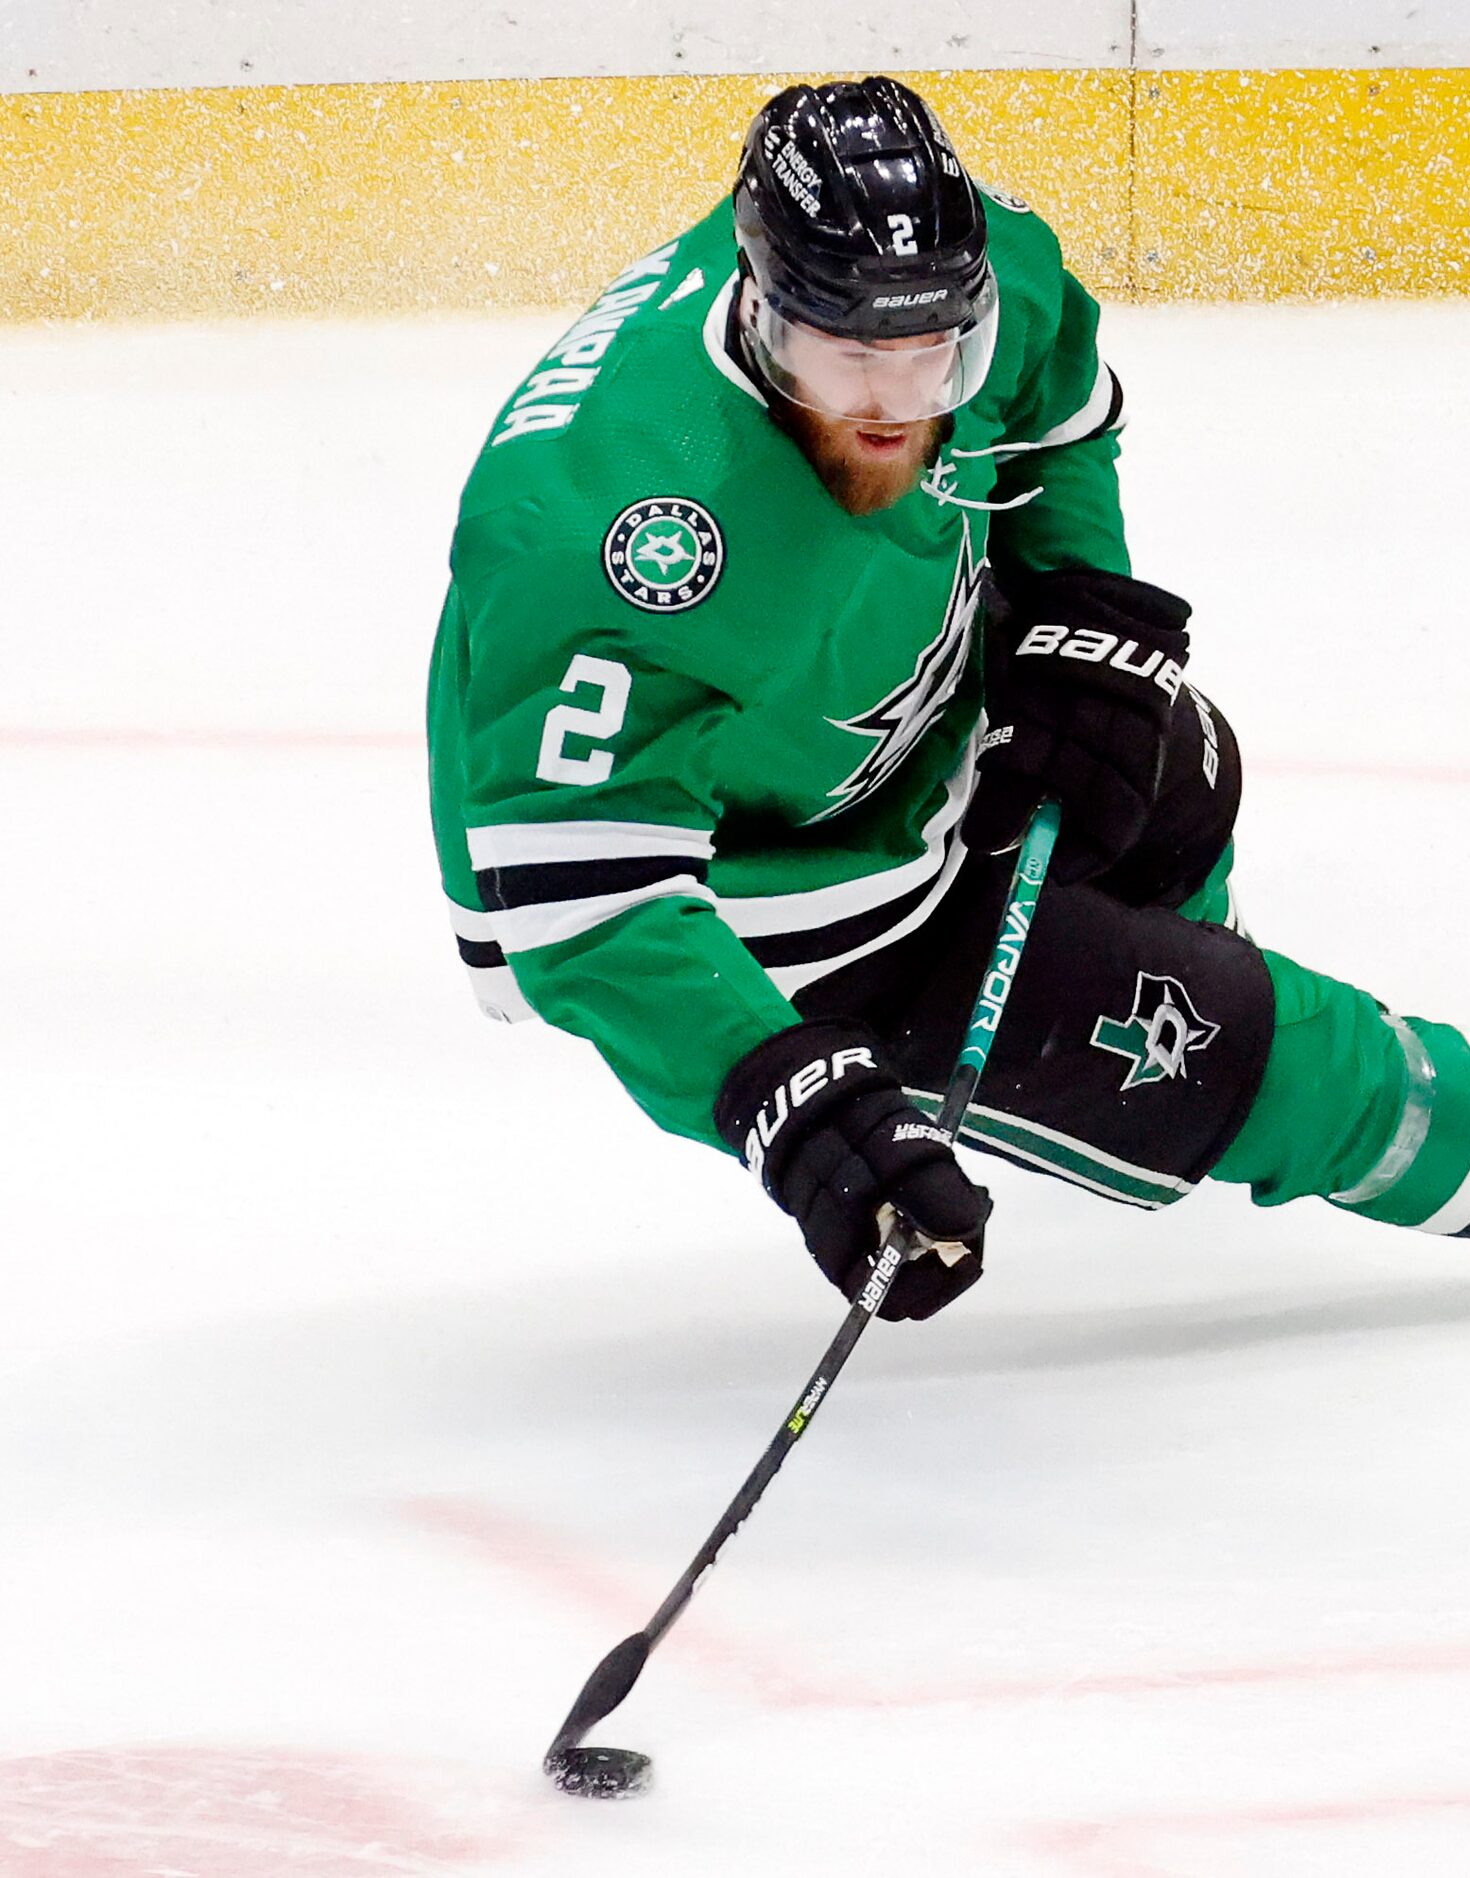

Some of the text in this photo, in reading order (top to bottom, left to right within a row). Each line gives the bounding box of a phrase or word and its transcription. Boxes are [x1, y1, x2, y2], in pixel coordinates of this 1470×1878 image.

[772, 153, 821, 218] TRANSFER
[781, 140, 823, 189] ENERGY
[886, 213, 919, 257] 2
[872, 287, 949, 309] BAUER
[625, 503, 717, 566] DALLAS
[611, 550, 694, 604] STARS
[1015, 624, 1184, 707] BAUE
[535, 653, 633, 786] 2
[971, 901, 1030, 1032] VAPOR
[744, 1046, 878, 1184] AUER
[857, 1245, 902, 1313] BAUER
